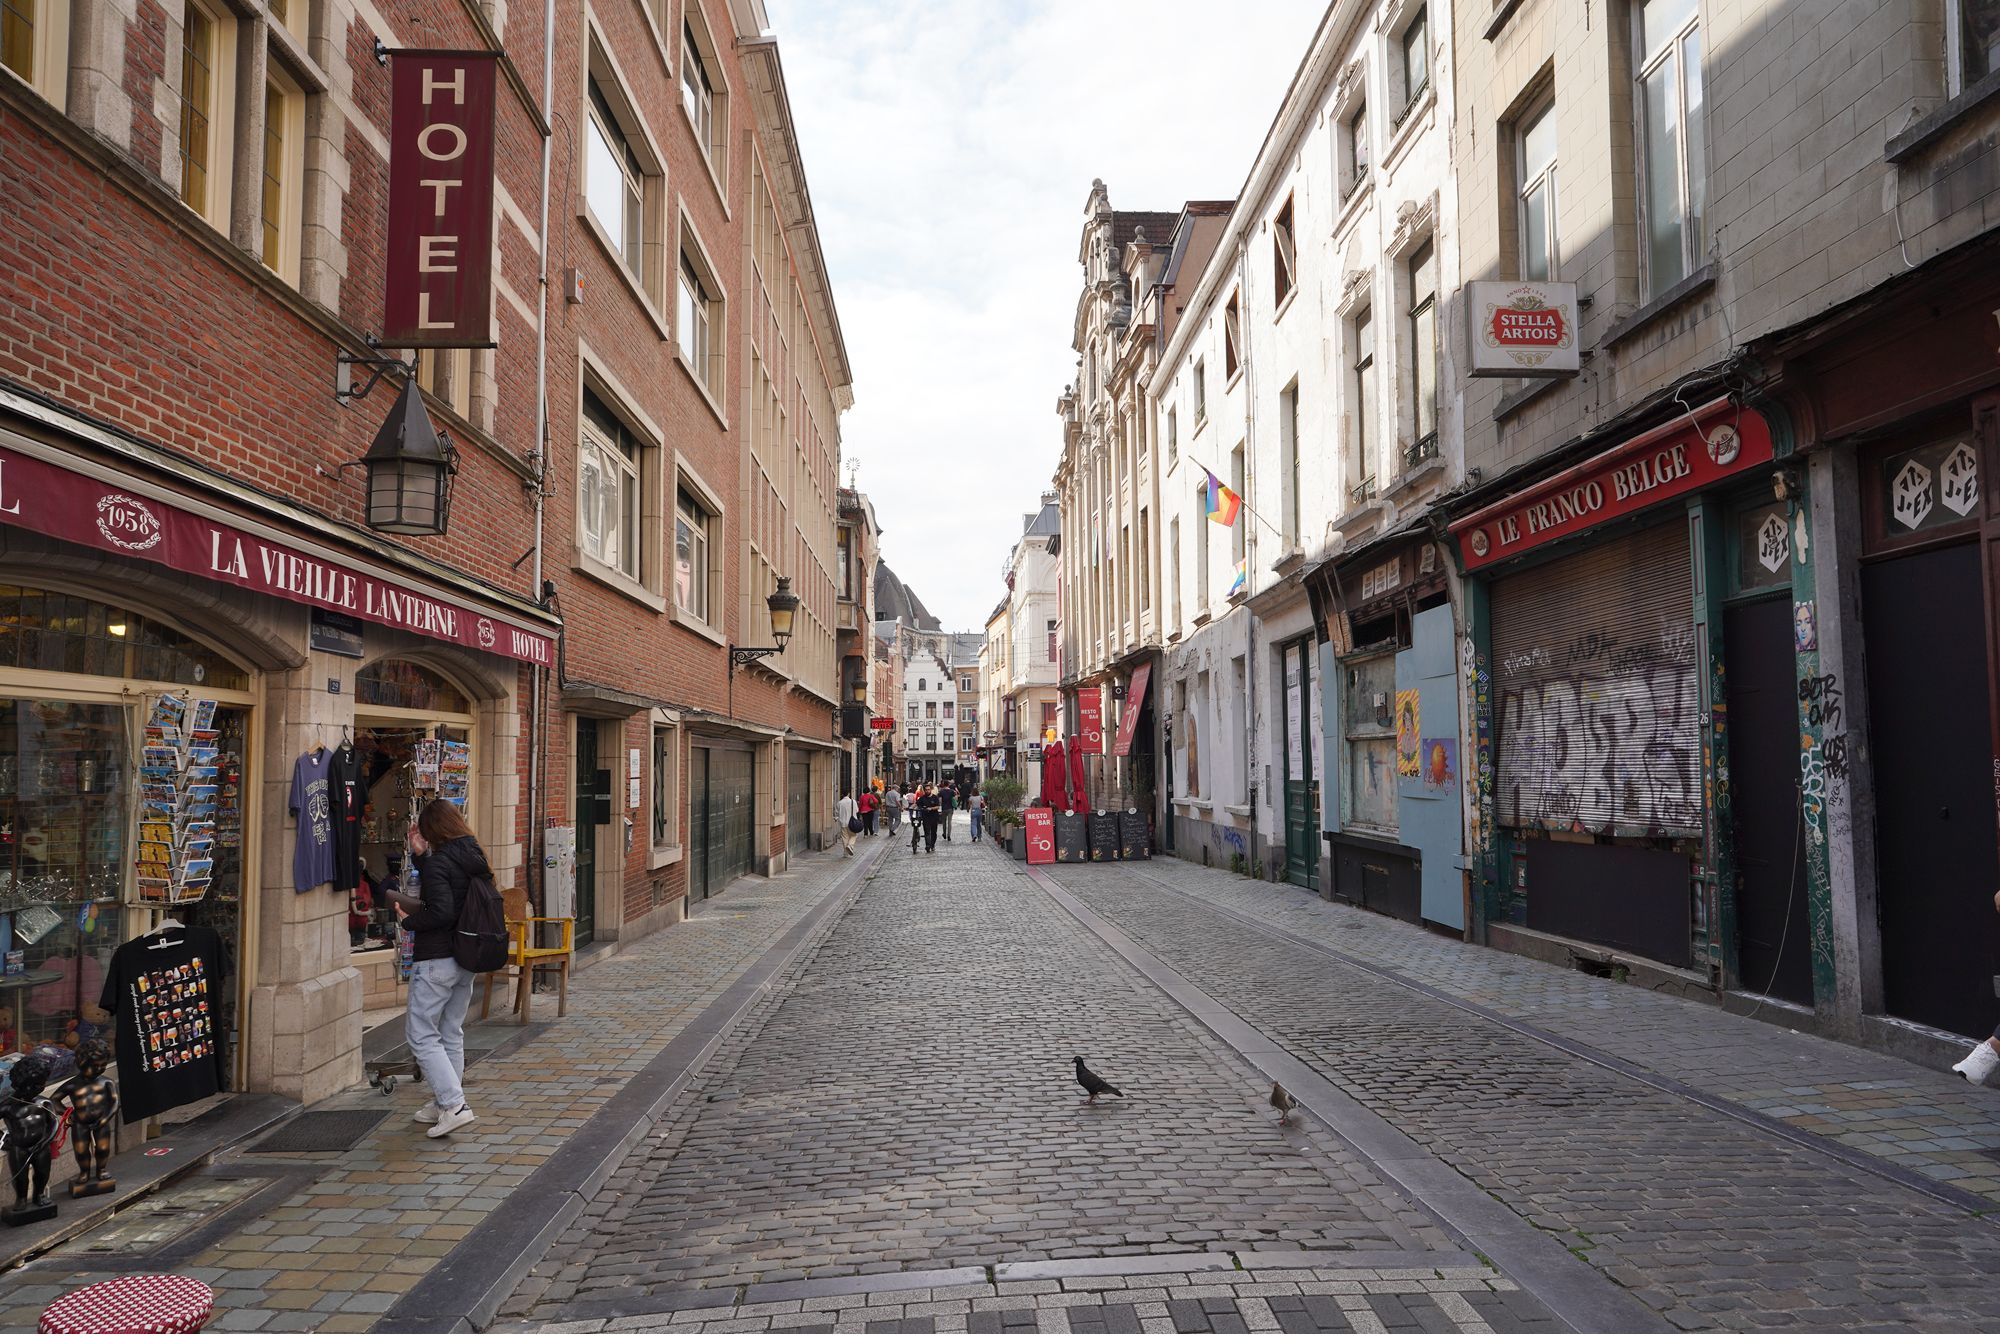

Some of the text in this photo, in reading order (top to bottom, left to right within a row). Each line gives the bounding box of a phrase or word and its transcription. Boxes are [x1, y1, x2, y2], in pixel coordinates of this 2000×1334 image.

[417, 68, 468, 329] HOTEL
[1506, 288, 1522, 298] ANNO
[1501, 314, 1556, 326] STELLA
[1501, 328, 1557, 340] ARTOIS
[1497, 443, 1692, 546] LE FRANCO BELGE
[107, 505, 150, 535] 1958
[210, 530, 459, 638] LA VIEILLE LANTERNE
[511, 630, 549, 663] HOTEL
[872, 721, 892, 729] FRITES
[1700, 712, 1709, 724] 26
